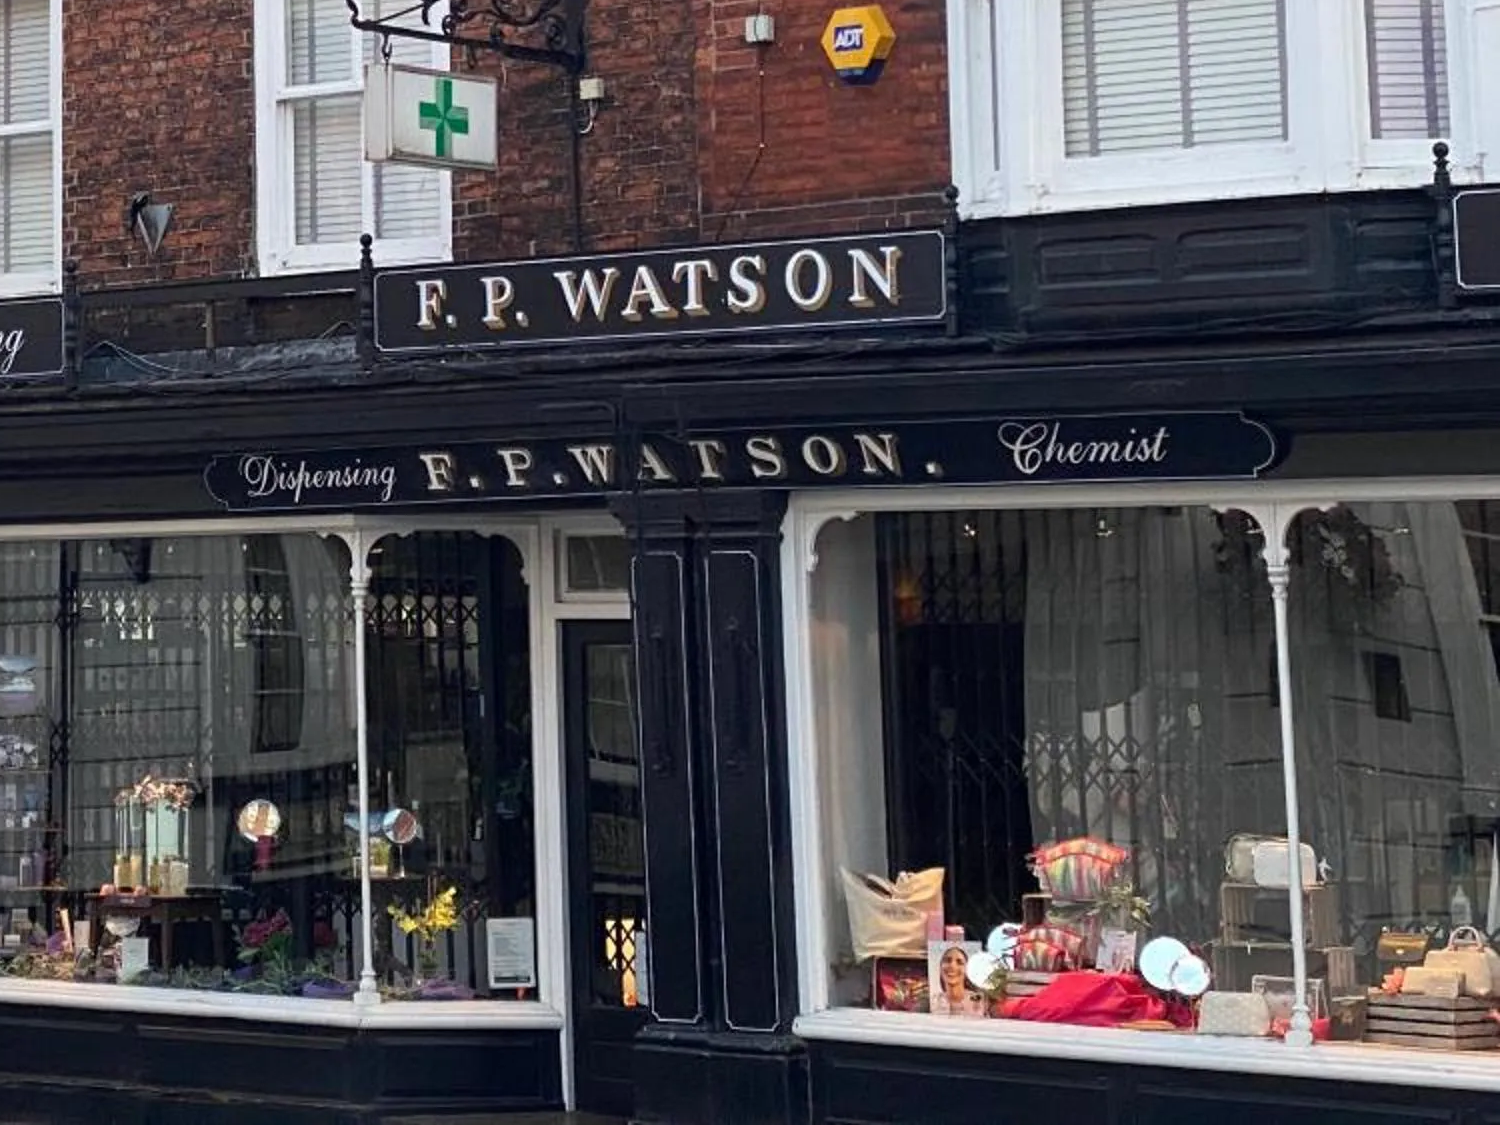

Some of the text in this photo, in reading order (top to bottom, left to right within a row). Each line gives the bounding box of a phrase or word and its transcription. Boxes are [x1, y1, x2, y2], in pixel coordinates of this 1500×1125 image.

[835, 28, 864, 47] ADT
[553, 245, 902, 322] WATSON
[241, 455, 396, 503] Dispensing
[998, 421, 1171, 474] Chemist
